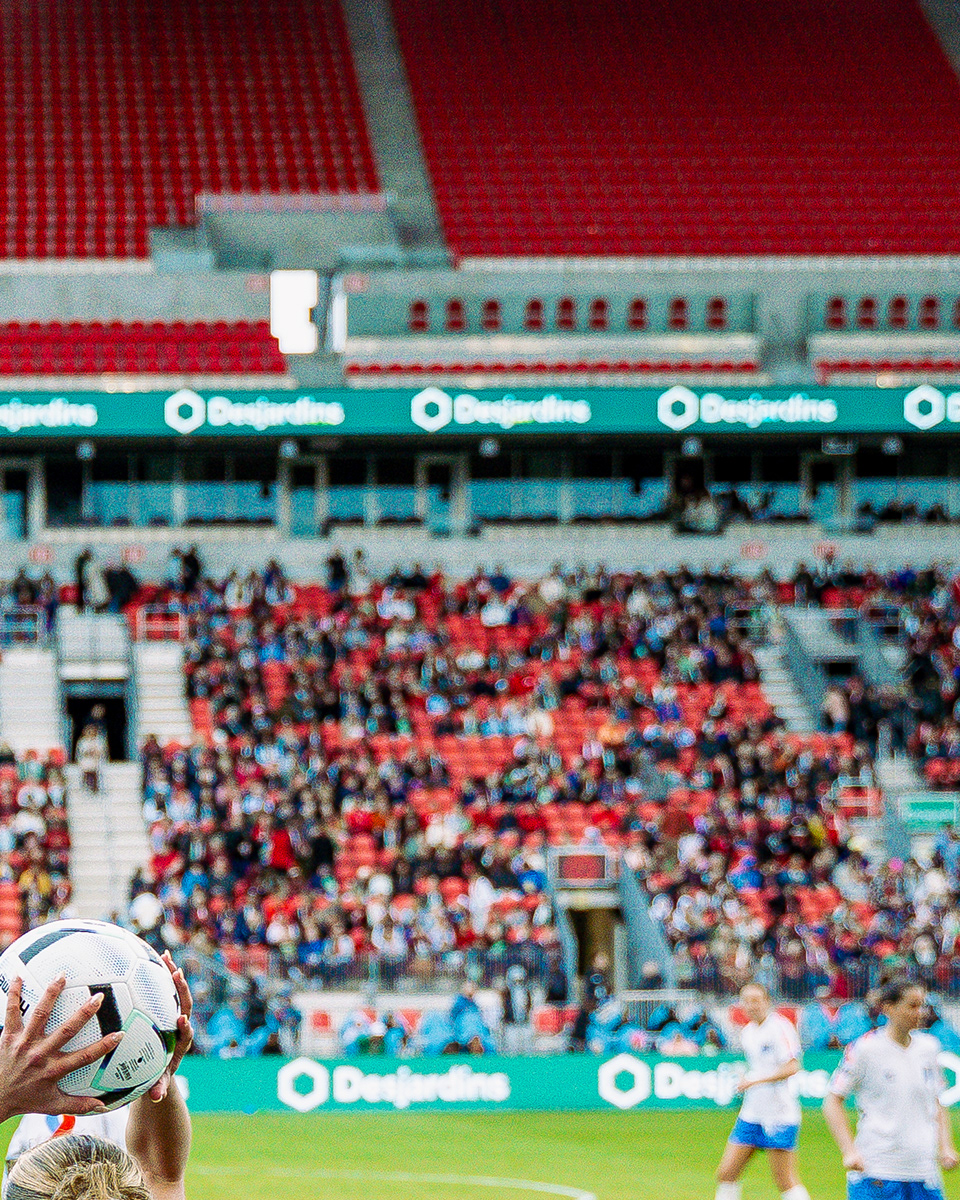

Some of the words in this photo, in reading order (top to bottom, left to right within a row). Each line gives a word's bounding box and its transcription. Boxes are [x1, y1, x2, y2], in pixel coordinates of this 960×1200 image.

[209, 397, 345, 432] Desjardins
[455, 395, 591, 430] Desjardins
[701, 394, 837, 429] Desjardins
[333, 1064, 510, 1109] Desjardins
